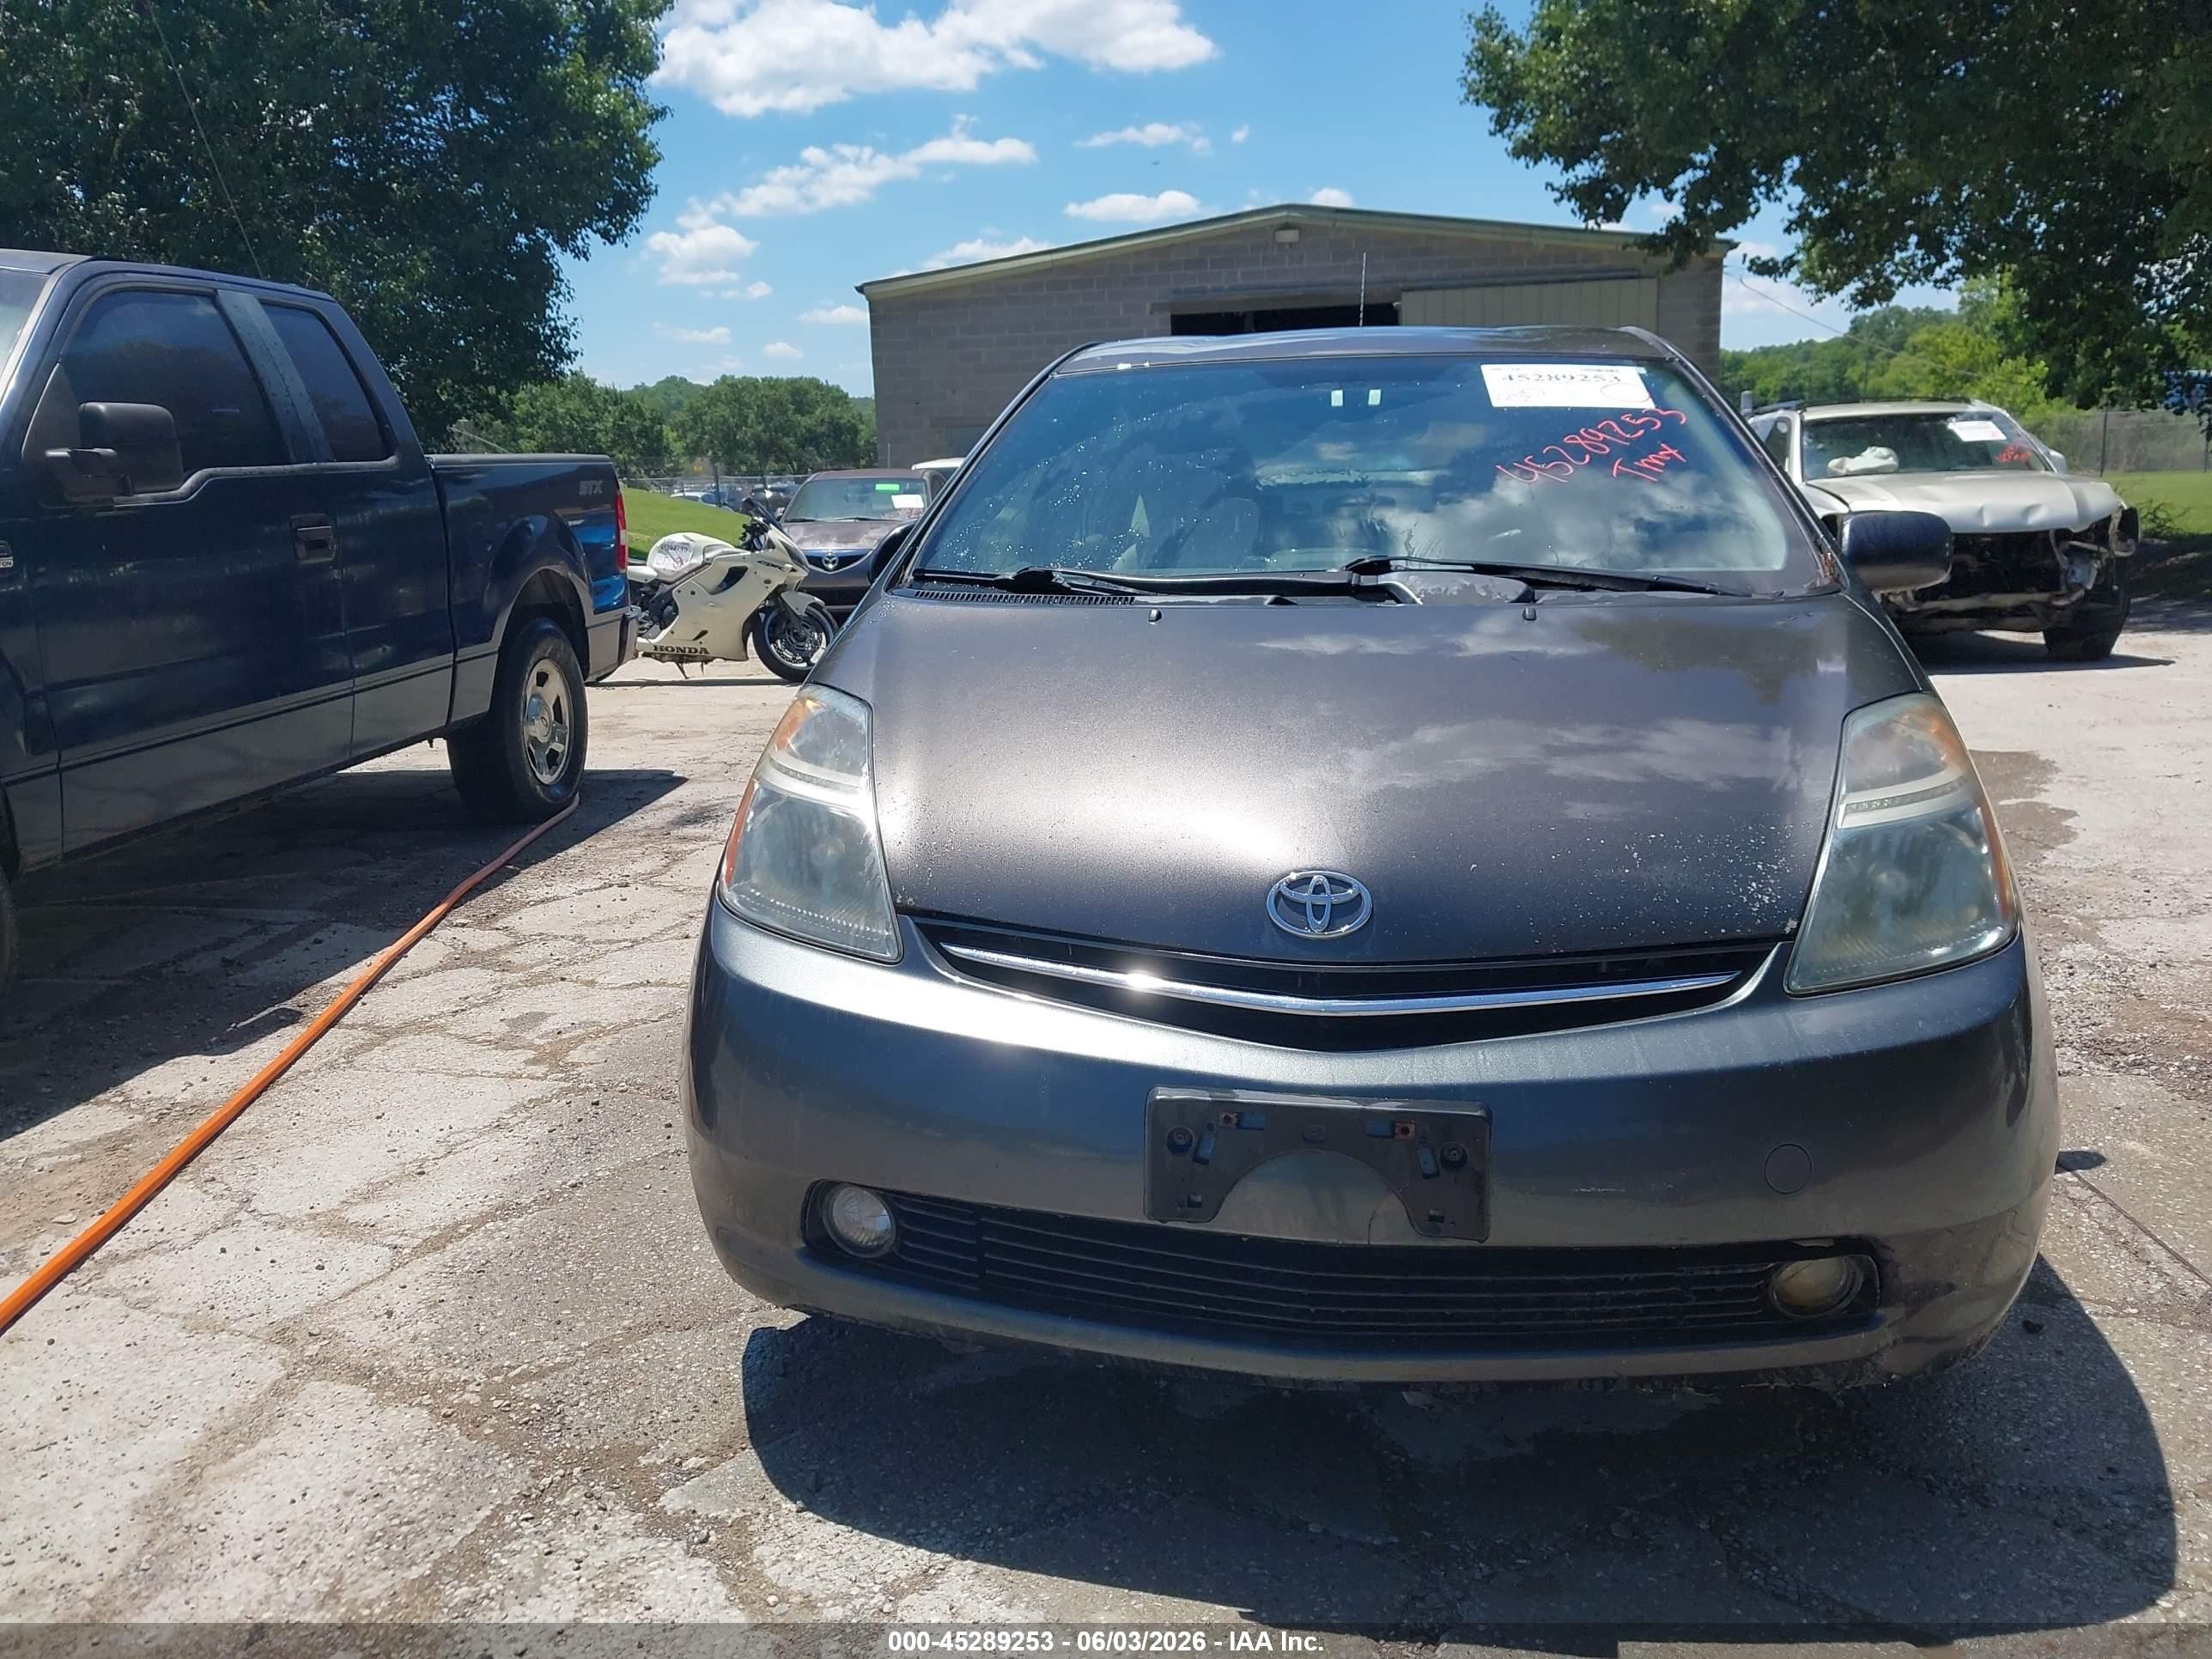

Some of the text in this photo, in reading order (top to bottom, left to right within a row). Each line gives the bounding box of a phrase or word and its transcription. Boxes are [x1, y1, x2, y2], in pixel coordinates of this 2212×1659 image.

[1496, 407, 1687, 483] 45289253
[578, 480, 603, 495] STX
[653, 644, 710, 655] HONDA
